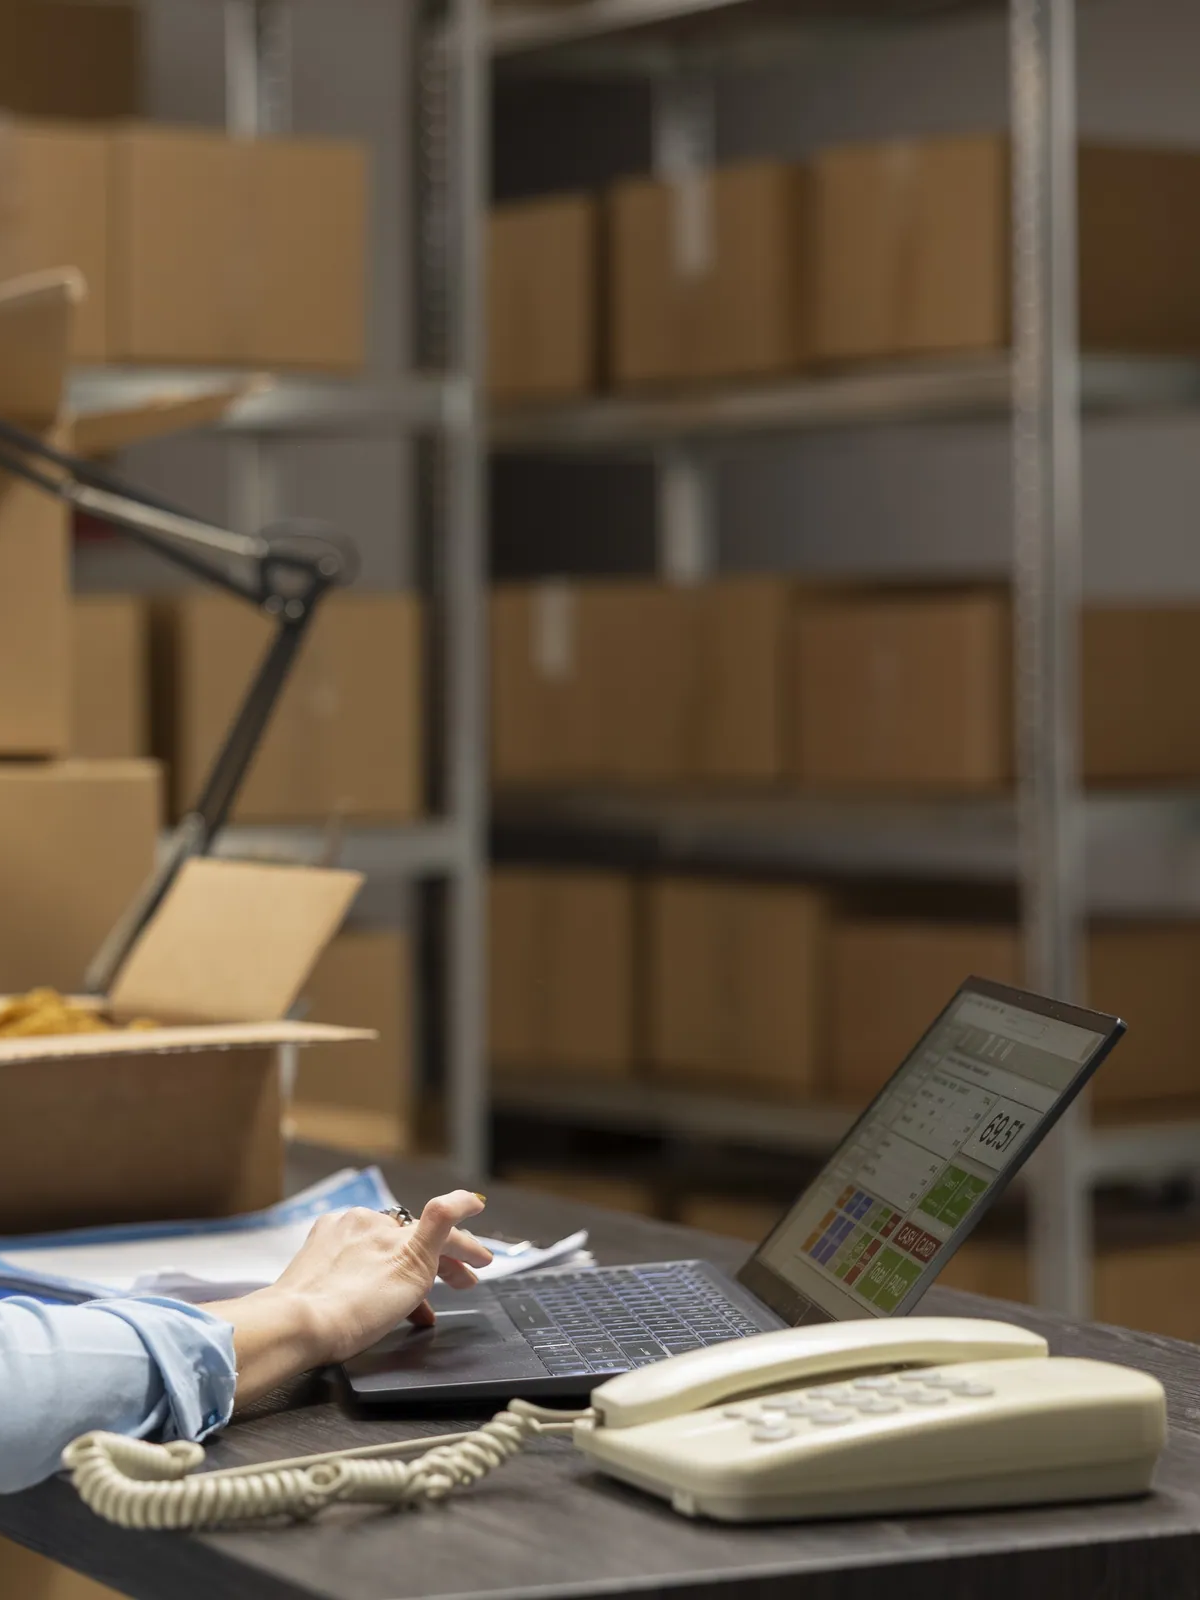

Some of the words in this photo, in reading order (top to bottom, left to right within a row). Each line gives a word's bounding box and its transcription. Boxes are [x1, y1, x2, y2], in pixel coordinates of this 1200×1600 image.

[898, 1226, 919, 1247] CASH
[915, 1237, 936, 1258] CARD
[869, 1261, 892, 1285] Total
[885, 1274, 908, 1297] PAID
